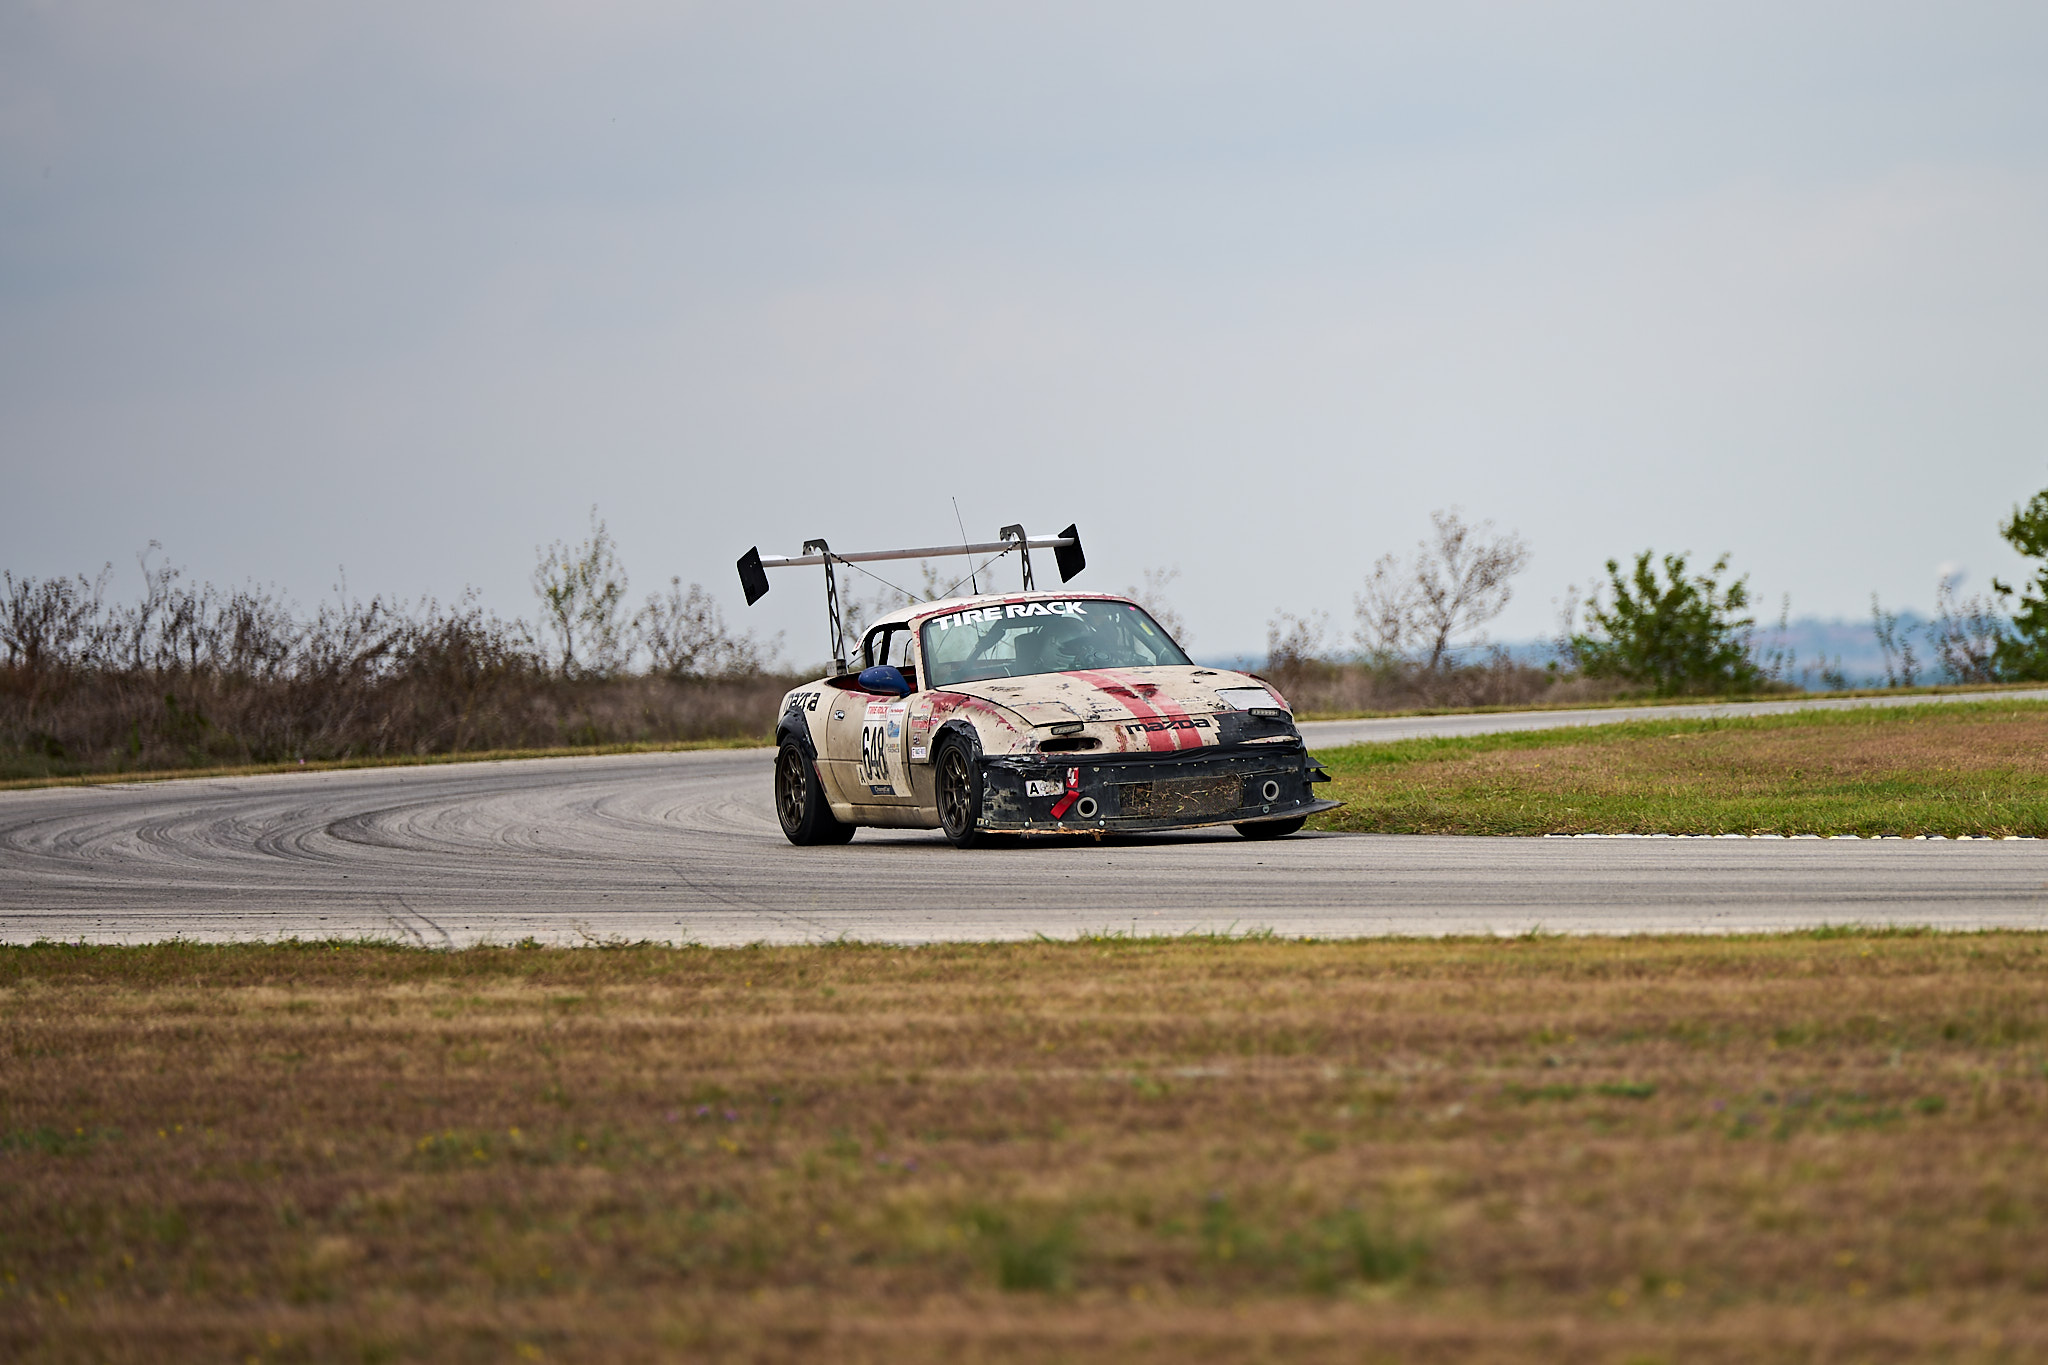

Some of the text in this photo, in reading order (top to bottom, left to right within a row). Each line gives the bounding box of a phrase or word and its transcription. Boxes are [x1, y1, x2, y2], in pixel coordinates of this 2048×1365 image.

[932, 602, 1087, 631] TIRE RACK
[862, 726, 888, 781] 648
[1030, 782, 1039, 795] A
